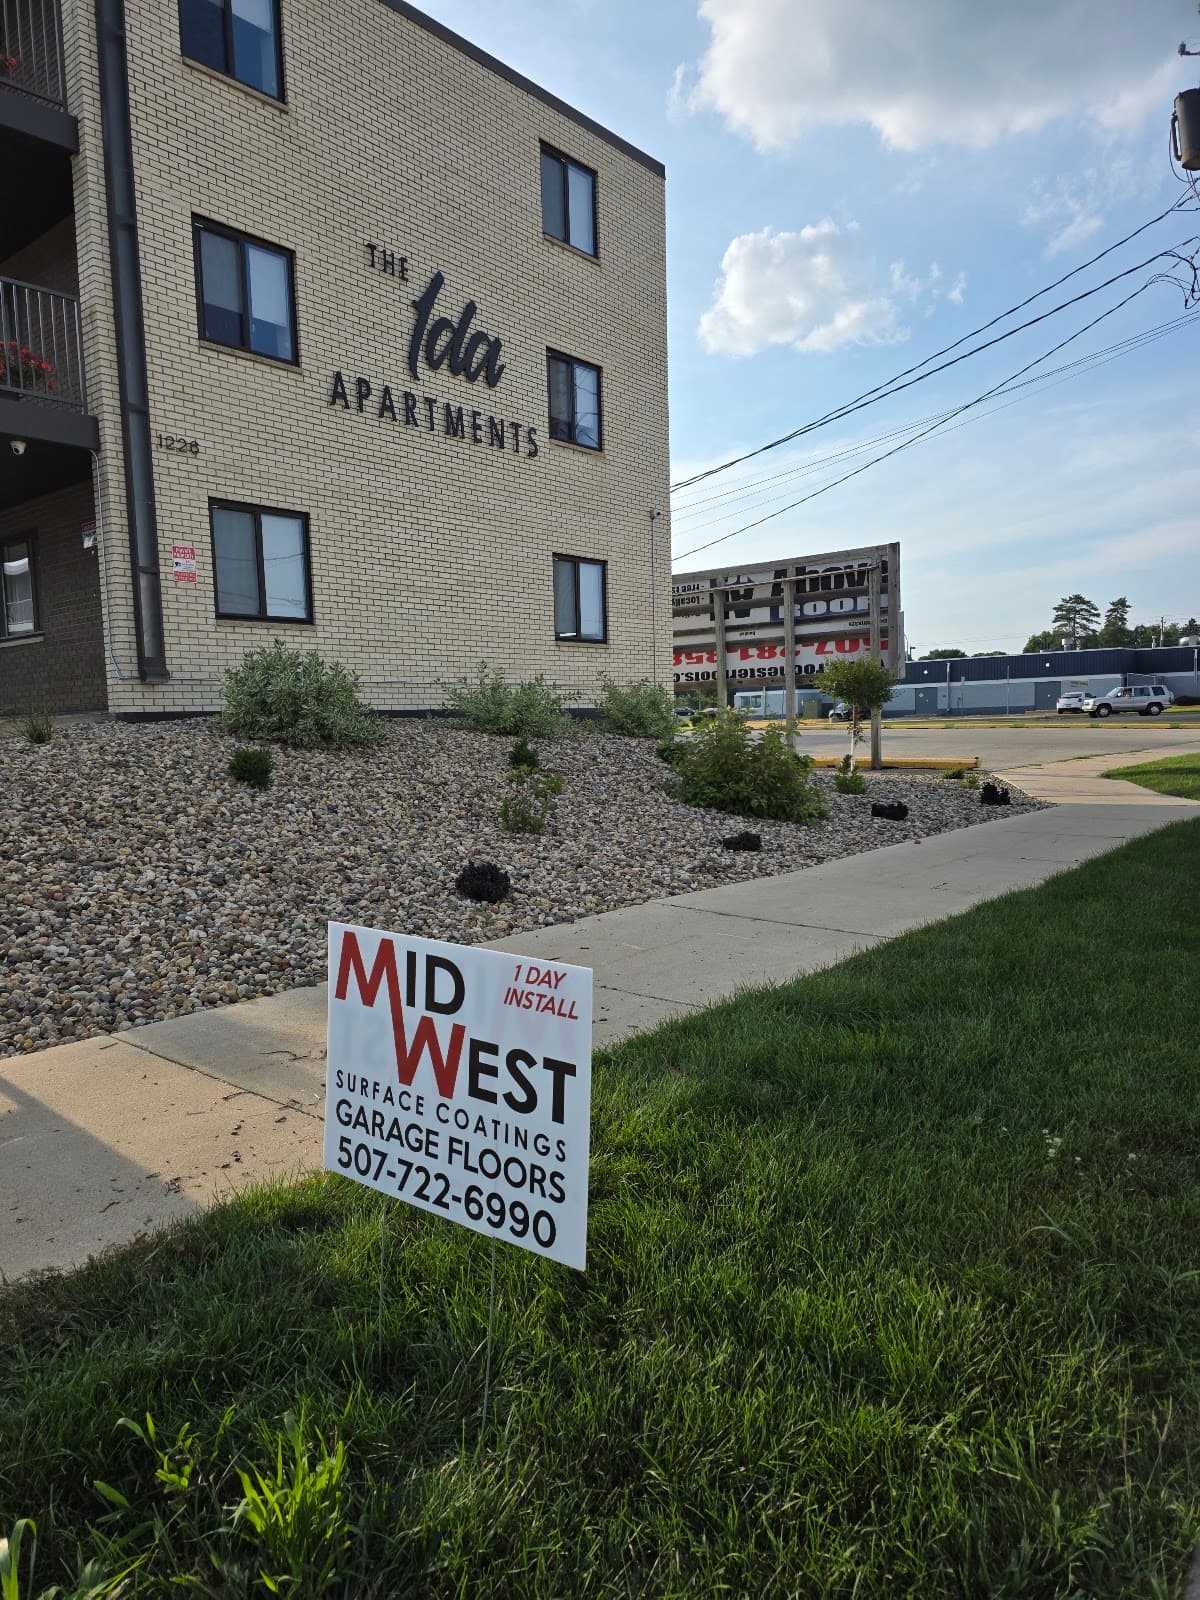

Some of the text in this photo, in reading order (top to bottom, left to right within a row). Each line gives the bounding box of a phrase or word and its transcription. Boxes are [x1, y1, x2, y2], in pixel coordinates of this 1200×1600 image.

[365, 242, 409, 282] THE
[408, 270, 506, 388] Ida
[329, 371, 539, 457] APARTMENTS
[335, 931, 466, 1015] MID
[503, 987, 580, 1020] INSTALL
[514, 964, 568, 990] 1 DAY
[390, 1014, 577, 1125] WEST
[336, 1069, 566, 1162] SURFACE COATINGS
[336, 1099, 566, 1204] GARAGE FLOORS
[337, 1136, 557, 1248] 507-722-6990
